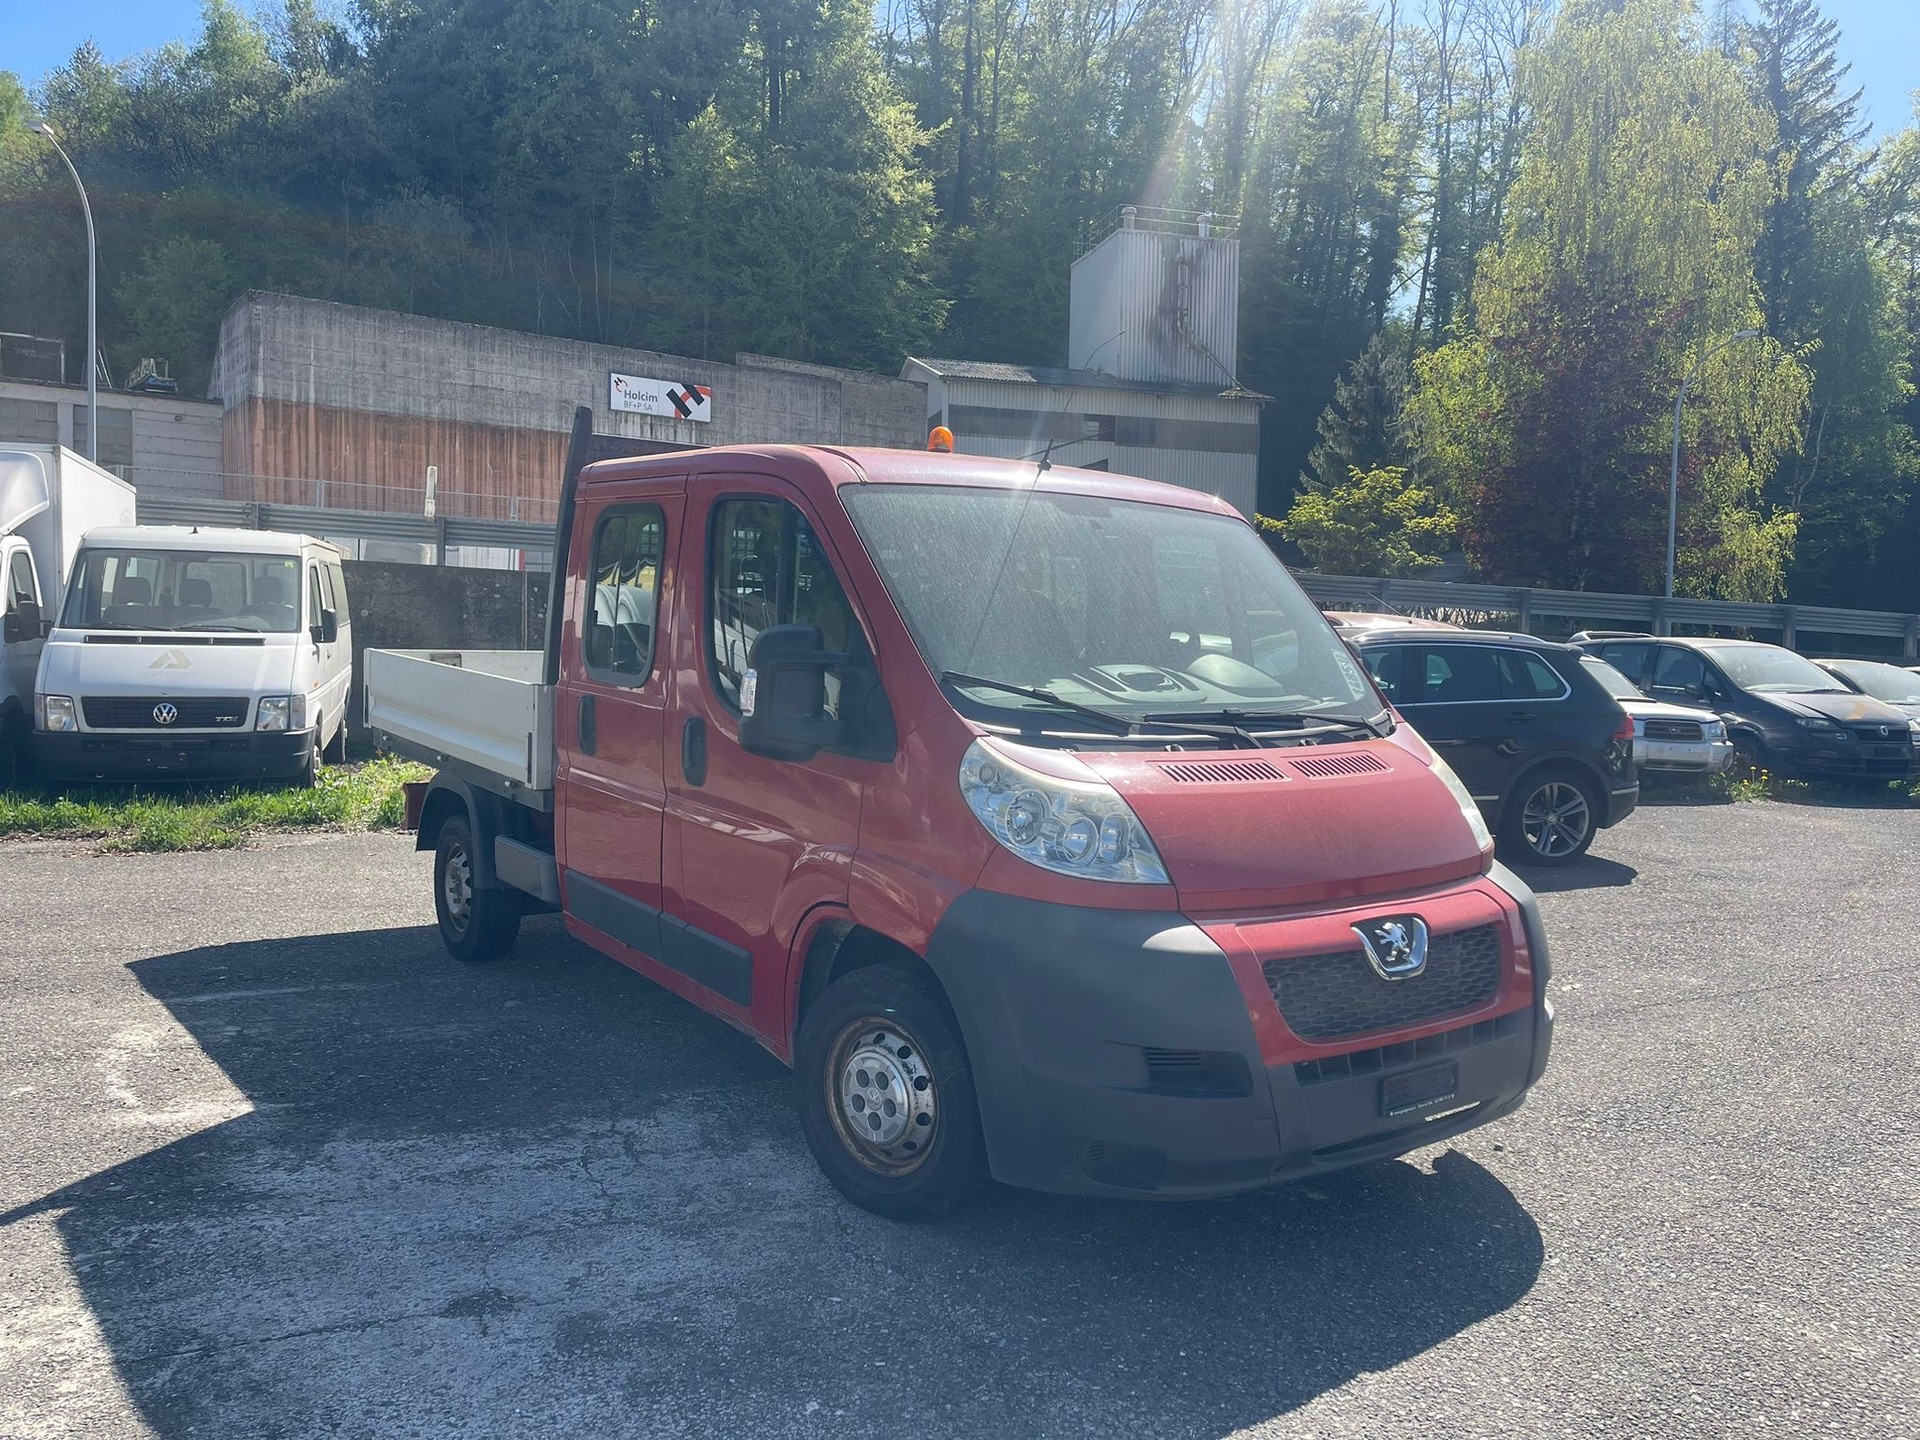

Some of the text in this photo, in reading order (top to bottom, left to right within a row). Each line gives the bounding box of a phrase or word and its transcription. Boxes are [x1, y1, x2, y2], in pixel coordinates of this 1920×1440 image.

[624, 389, 658, 403] Holcim
[623, 400, 653, 411] BF+P SA
